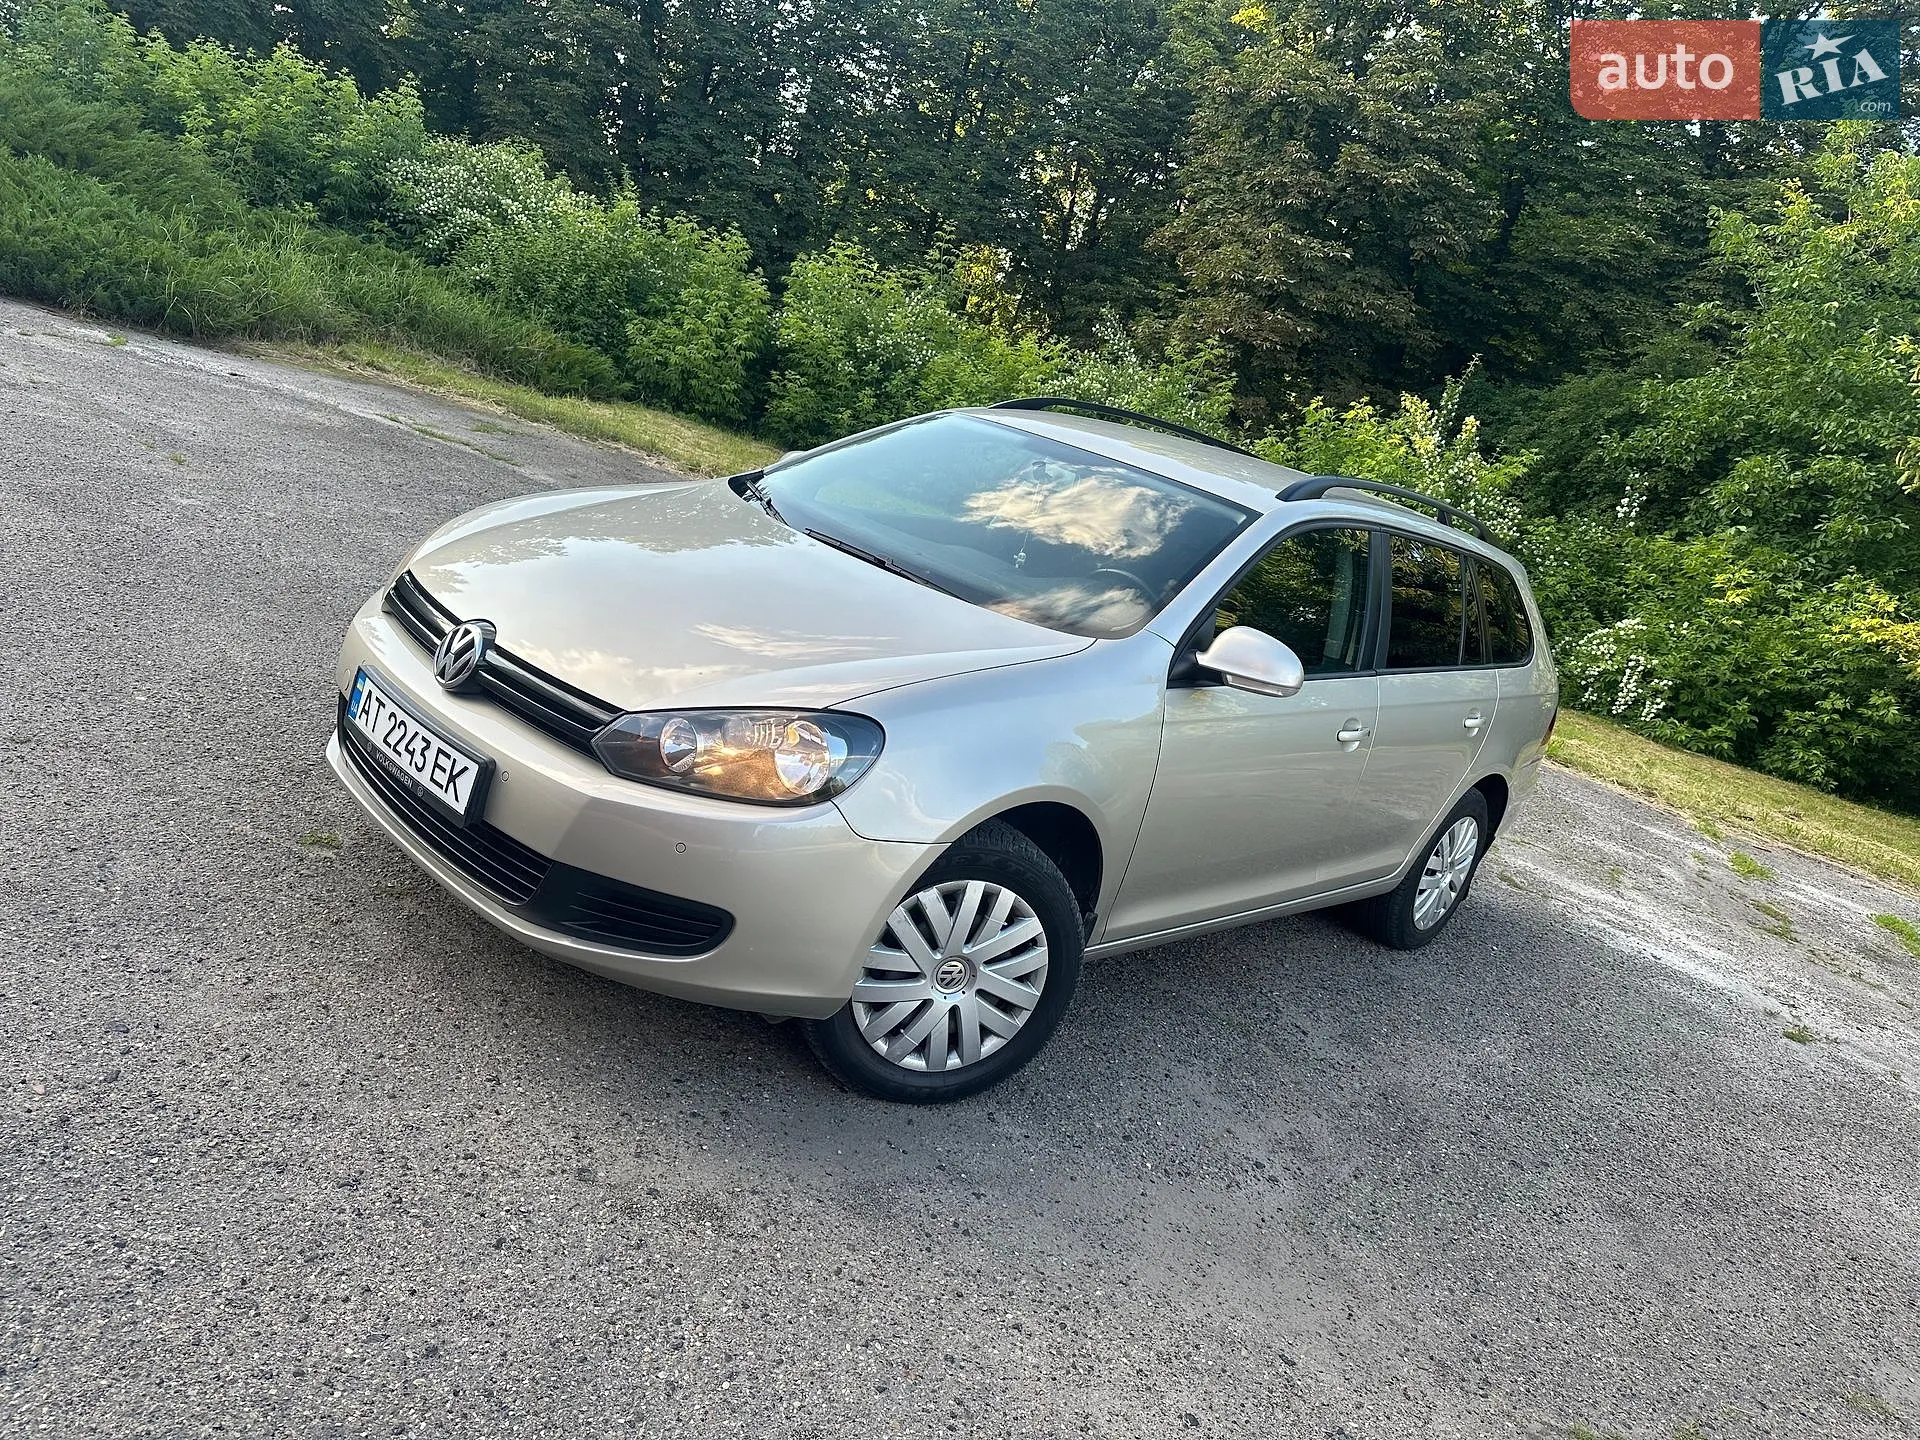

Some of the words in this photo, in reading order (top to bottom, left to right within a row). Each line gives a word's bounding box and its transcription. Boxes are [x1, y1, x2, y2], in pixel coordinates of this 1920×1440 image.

[358, 689, 386, 733] AT
[382, 711, 432, 773] 2243
[429, 746, 469, 803] EK
[376, 749, 413, 788] VOLKSWAGEN
